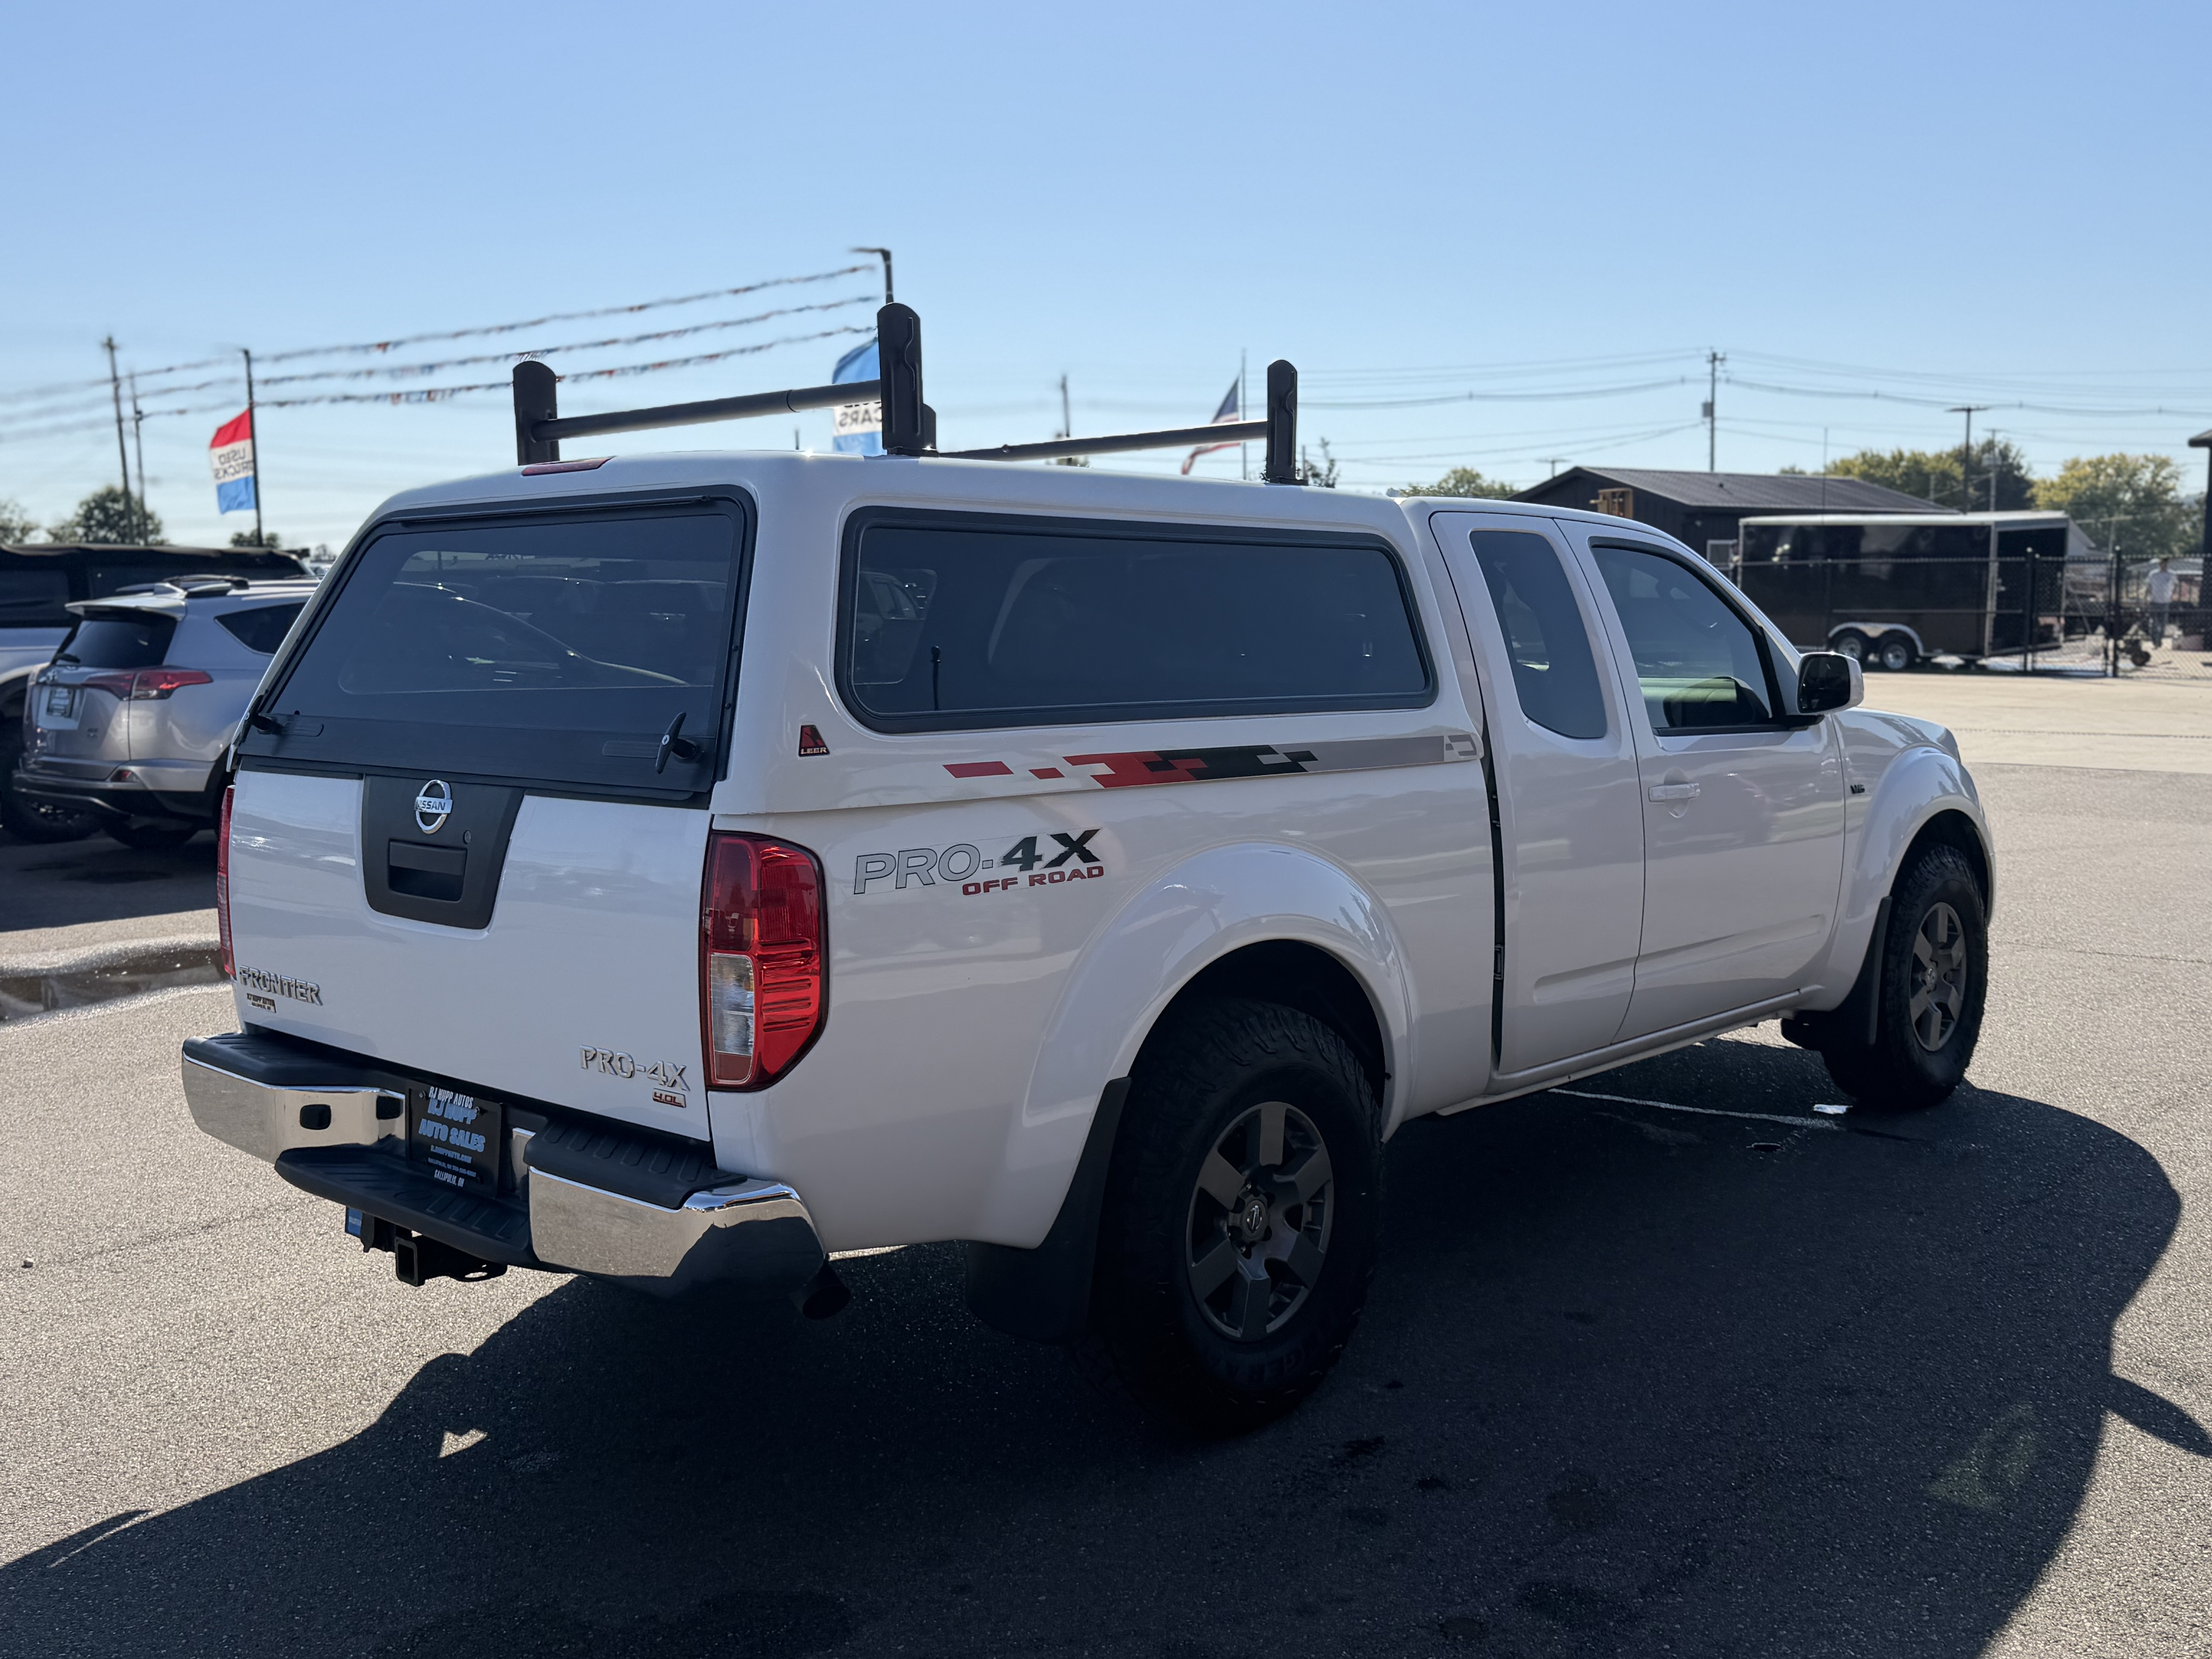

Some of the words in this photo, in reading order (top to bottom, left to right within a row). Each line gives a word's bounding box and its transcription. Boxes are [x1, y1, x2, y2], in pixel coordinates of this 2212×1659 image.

[415, 799, 446, 811] NISSAN
[962, 877, 1018, 896] OFF
[1029, 866, 1104, 886] ROAD
[239, 965, 323, 1006] FRONTIER
[580, 1044, 691, 1091] PRO-4X
[429, 1086, 438, 1099] RJ
[453, 1093, 474, 1109] AUTOS
[653, 1092, 682, 1106] 4.0L
[419, 1118, 448, 1141] AUTO
[449, 1127, 486, 1152] SALES
